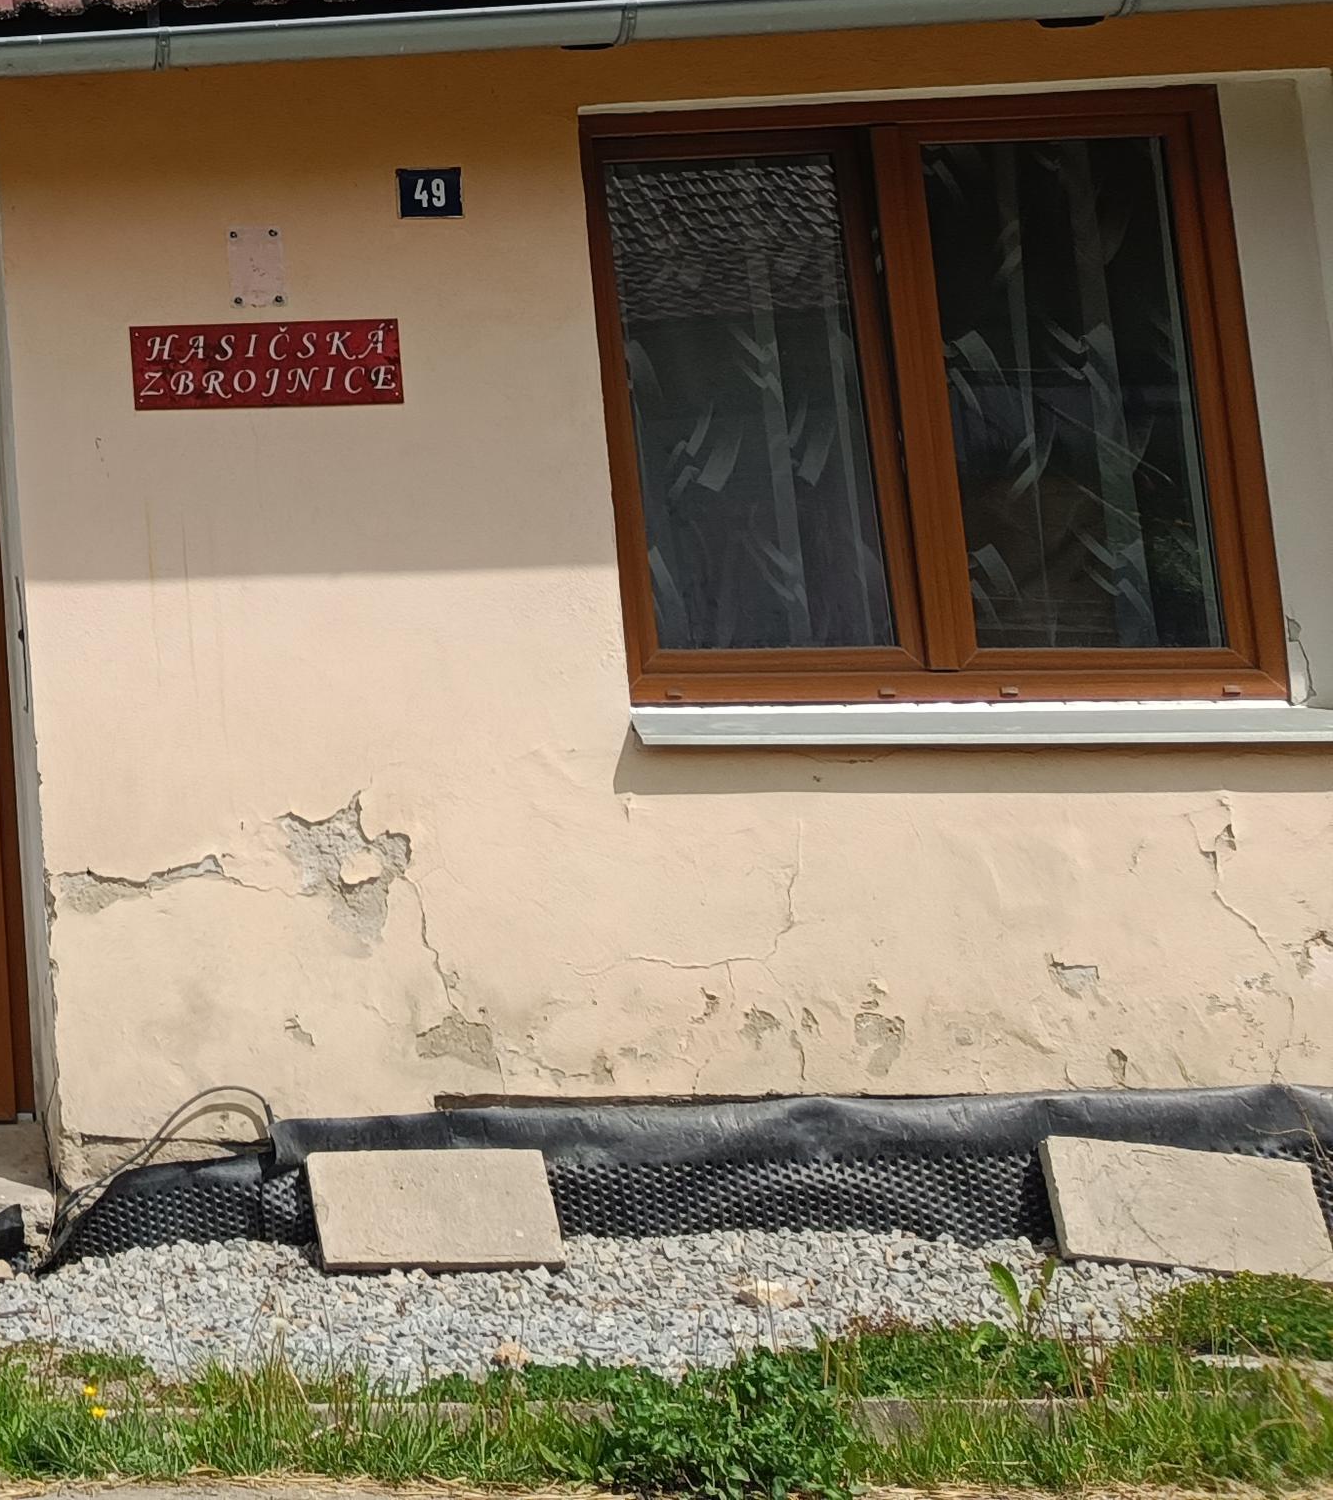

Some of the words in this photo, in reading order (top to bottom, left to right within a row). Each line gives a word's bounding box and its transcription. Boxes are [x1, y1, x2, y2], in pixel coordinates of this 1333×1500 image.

[414, 178, 446, 207] 49
[146, 323, 384, 363] HASIČSKÁ
[140, 365, 396, 399] ZBROJNICE
